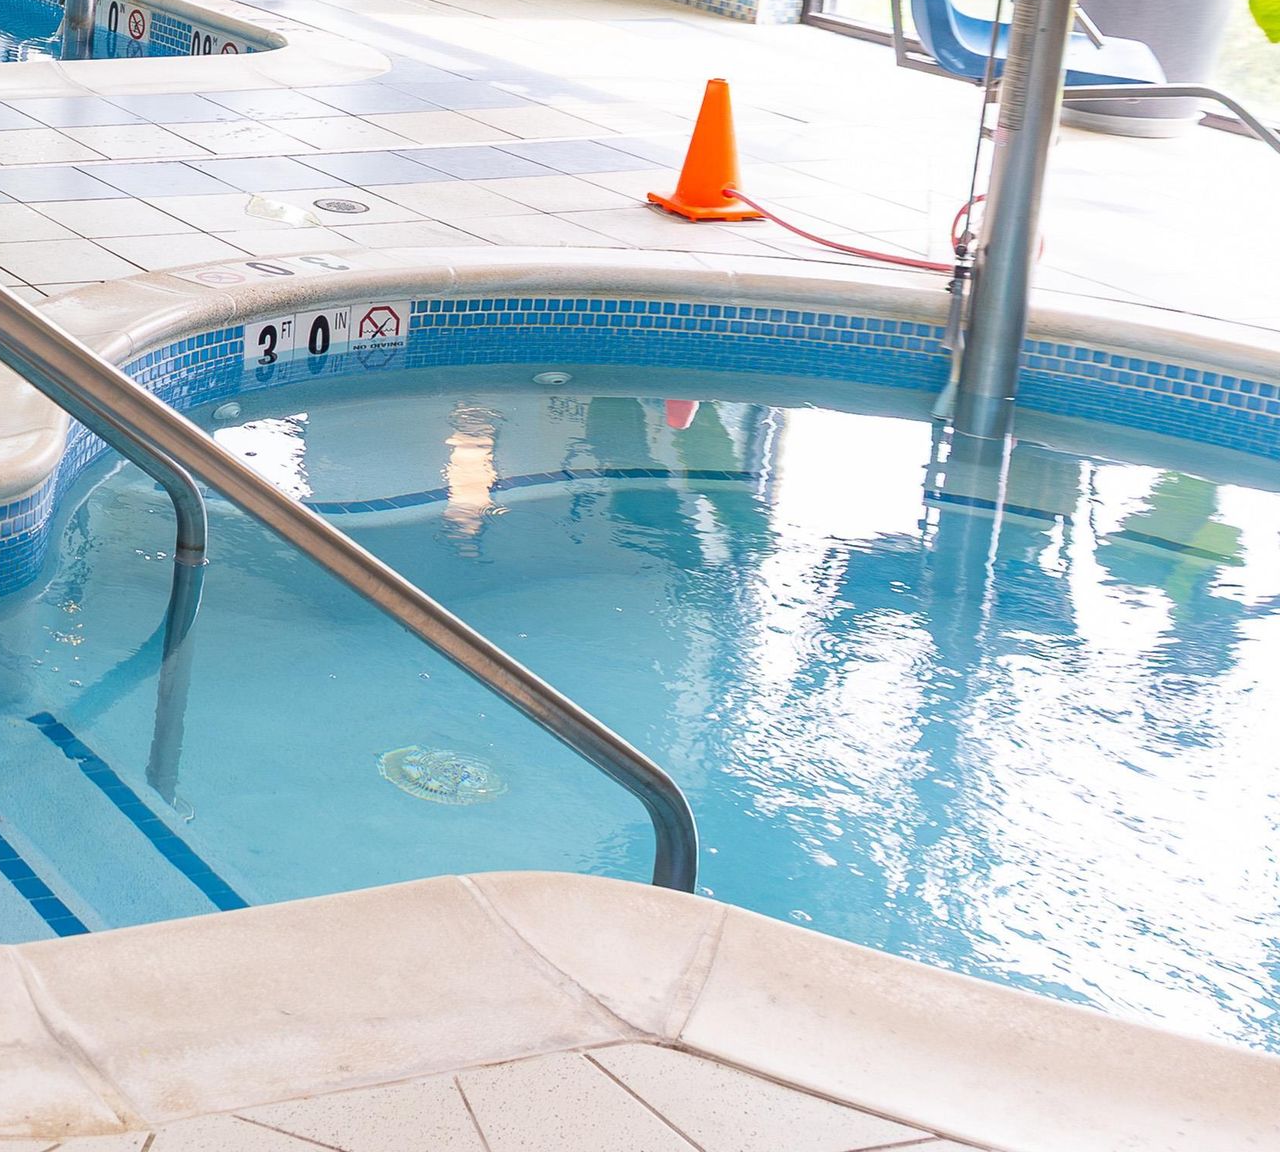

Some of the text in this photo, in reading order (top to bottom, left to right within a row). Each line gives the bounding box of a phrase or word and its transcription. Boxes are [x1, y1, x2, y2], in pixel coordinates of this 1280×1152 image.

[108, 1, 119, 33] 0
[258, 312, 348, 365] 3 FT 0 IN
[370, 341, 404, 349] DIVING
